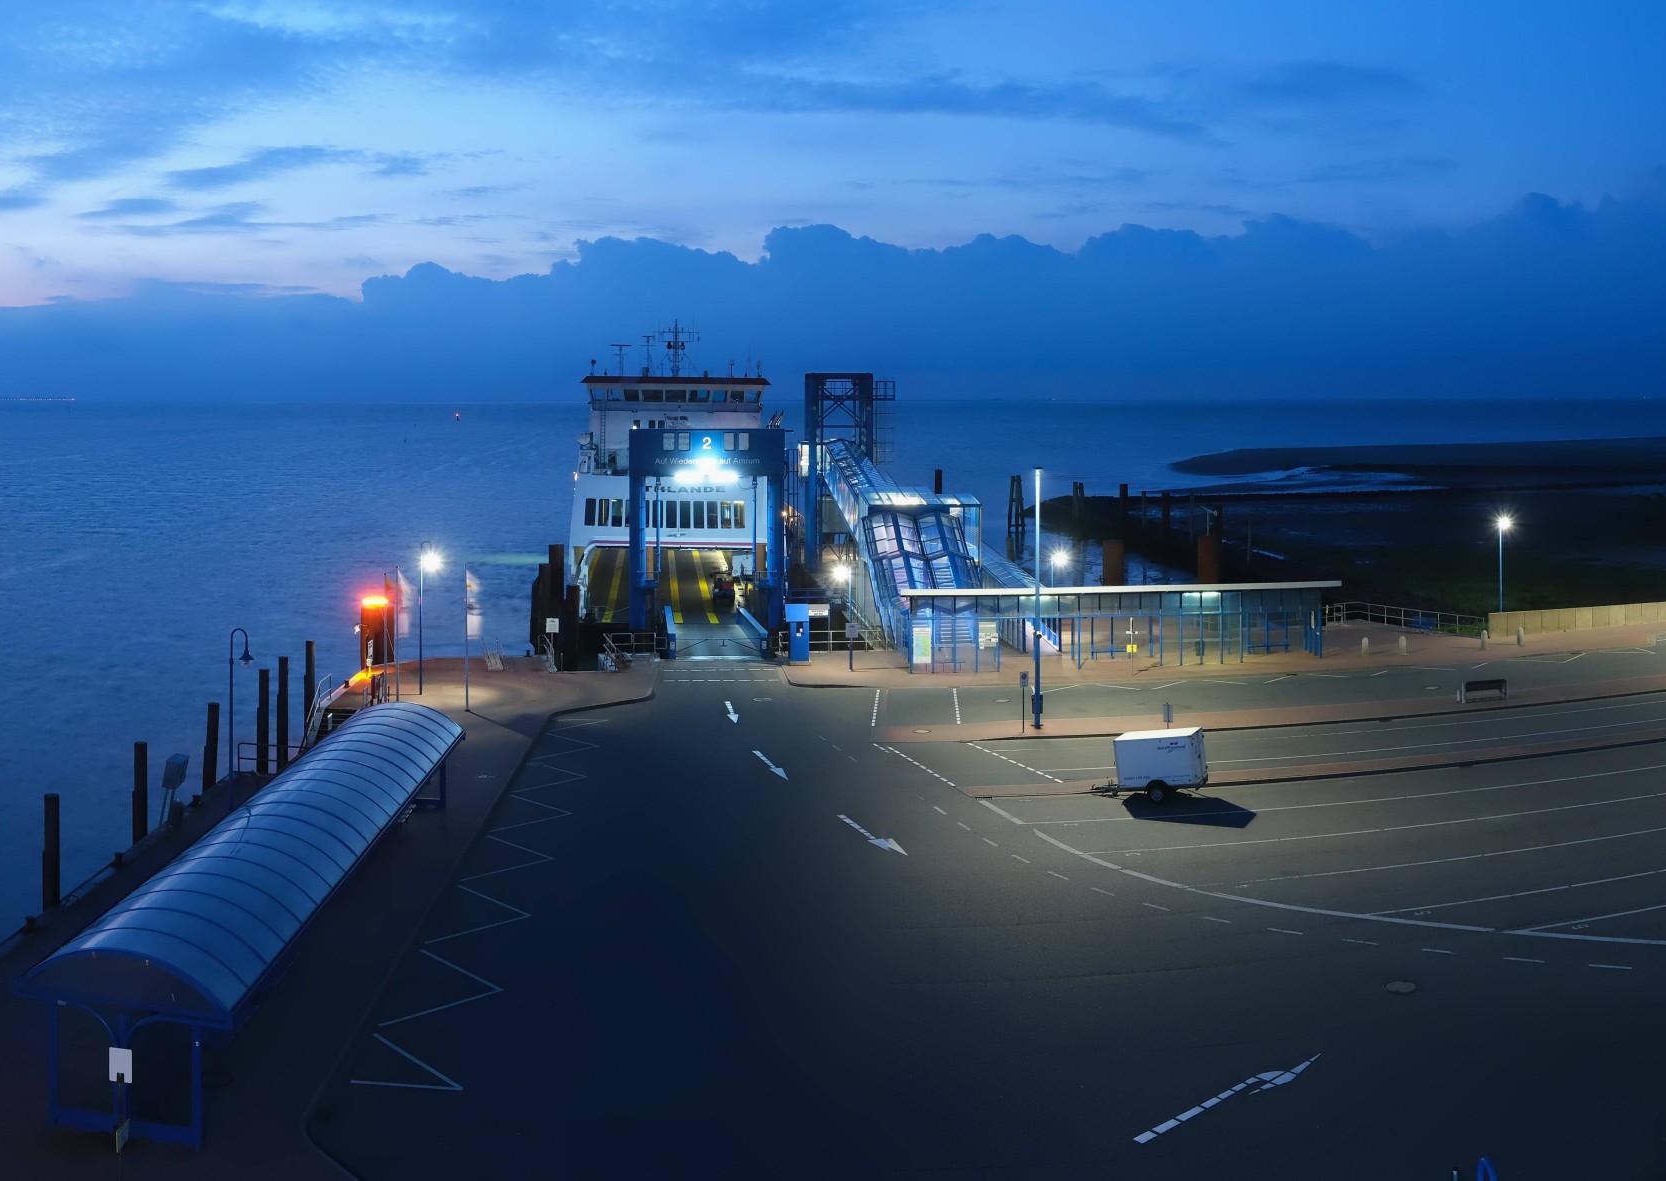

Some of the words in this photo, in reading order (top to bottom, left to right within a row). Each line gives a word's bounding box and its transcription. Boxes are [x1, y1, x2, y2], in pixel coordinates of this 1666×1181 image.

[702, 436, 712, 450] 2
[655, 457, 668, 465] Auf
[719, 457, 732, 465] auf
[733, 457, 760, 465] Amrum
